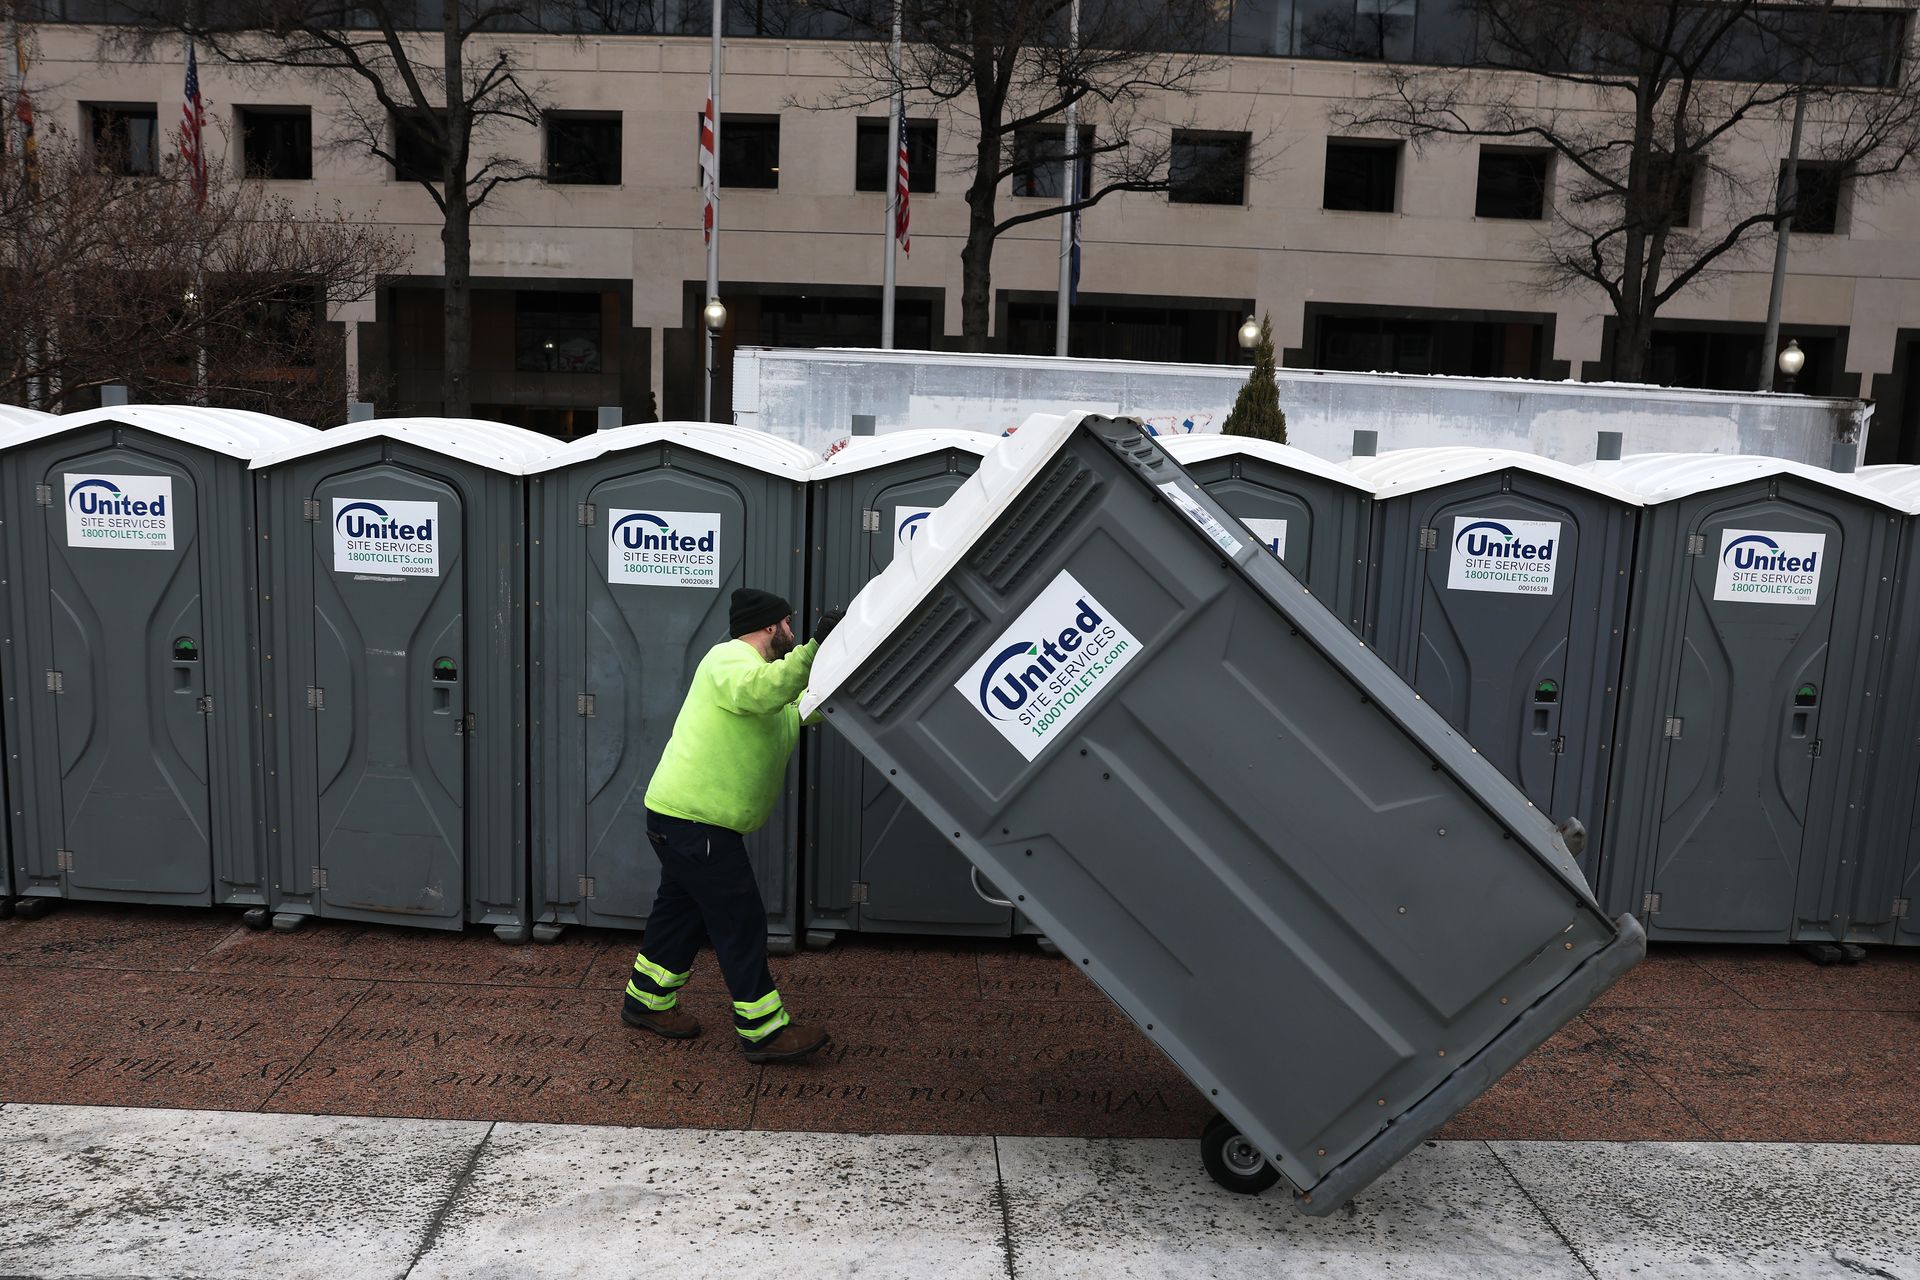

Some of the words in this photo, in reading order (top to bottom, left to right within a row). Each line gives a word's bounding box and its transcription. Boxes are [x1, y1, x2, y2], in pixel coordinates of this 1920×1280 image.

[79, 492, 165, 516] United
[81, 517, 104, 527] SITE
[108, 518, 166, 529] SERVICES
[346, 515, 432, 541] United
[82, 529, 166, 540] 1800TOILETS.com
[623, 526, 714, 552] United
[347, 540, 371, 551] SITE
[375, 541, 432, 553] SERVICES
[1467, 533, 1554, 560] United
[348, 552, 432, 564] 1800TOILETS.com
[623, 552, 649, 562] SITE
[653, 553, 714, 564] SERVICES
[1465, 558, 1491, 569] SITE
[1495, 560, 1551, 572] SERVICES
[1734, 547, 1817, 573] United
[624, 564, 713, 576] 1800TOILETS.com
[1465, 570, 1549, 583] 1800TOILETS.com
[1732, 572, 1757, 582] SITE
[1760, 573, 1814, 584] SERVICES
[1731, 583, 1812, 595] 1800TOILETS.com
[991, 598, 1103, 711] United
[1018, 692, 1052, 726] SITE
[1049, 625, 1116, 694] SERVICES
[1031, 640, 1129, 738] 1800TOILETS.com
[67, 1057, 216, 1082] which
[240, 1060, 338, 1086] city
[368, 1070, 405, 1083] a
[431, 1072, 554, 1099] have
[587, 1078, 633, 1096] to
[671, 1080, 706, 1100] is
[742, 1083, 868, 1100] want
[908, 1085, 995, 1104] you
[1035, 1090, 1171, 1114] What
